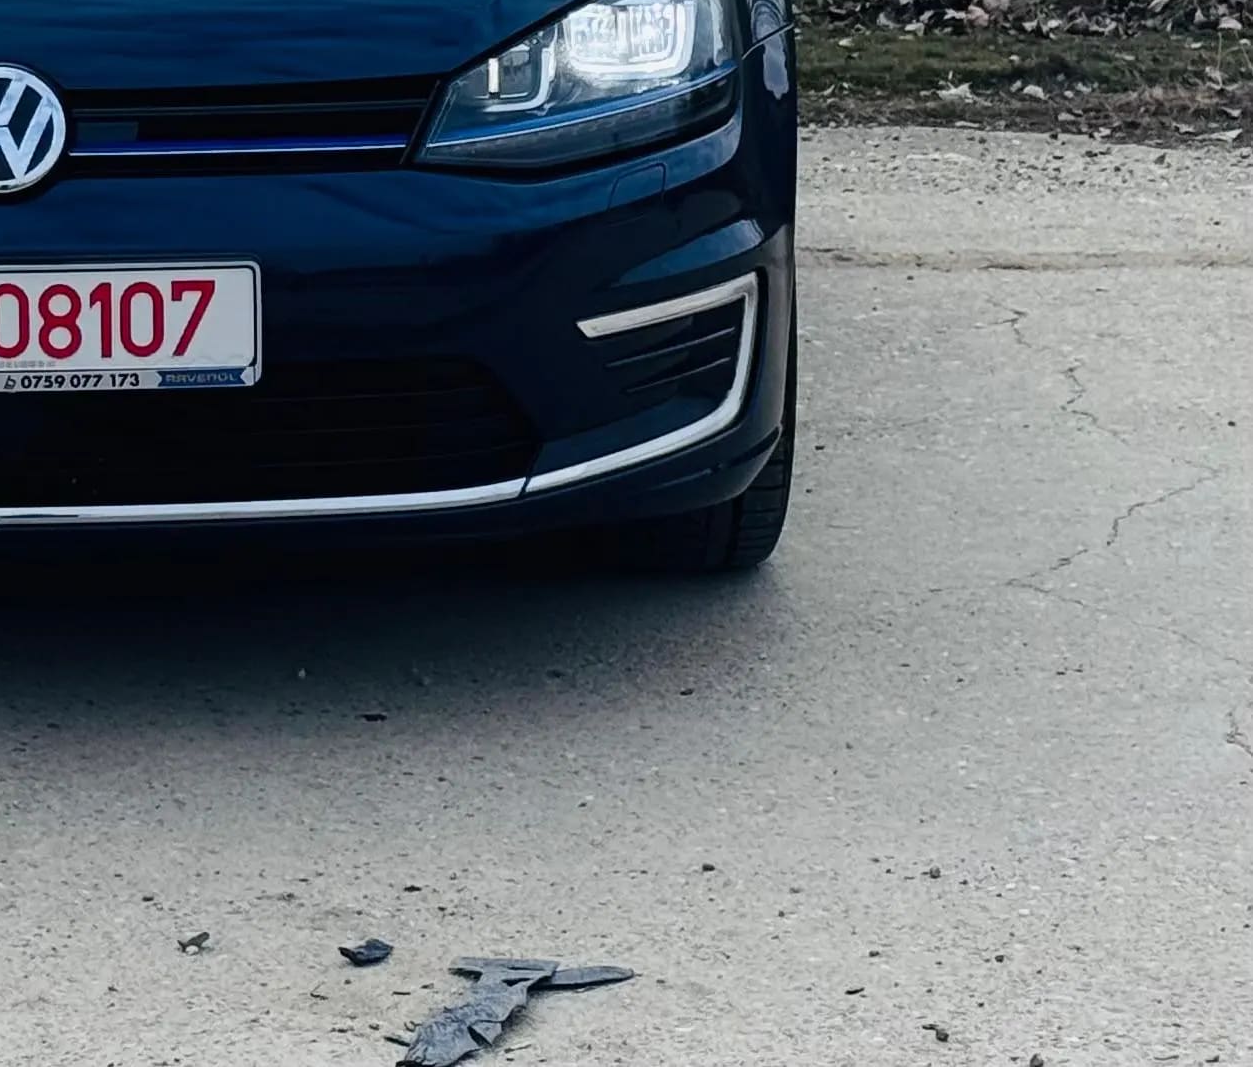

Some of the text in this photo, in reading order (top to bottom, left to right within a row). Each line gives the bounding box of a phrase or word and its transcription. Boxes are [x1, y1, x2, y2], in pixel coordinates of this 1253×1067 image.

[20, 374, 66, 389] 0759
[70, 373, 104, 389] 077
[109, 372, 140, 388] 173
